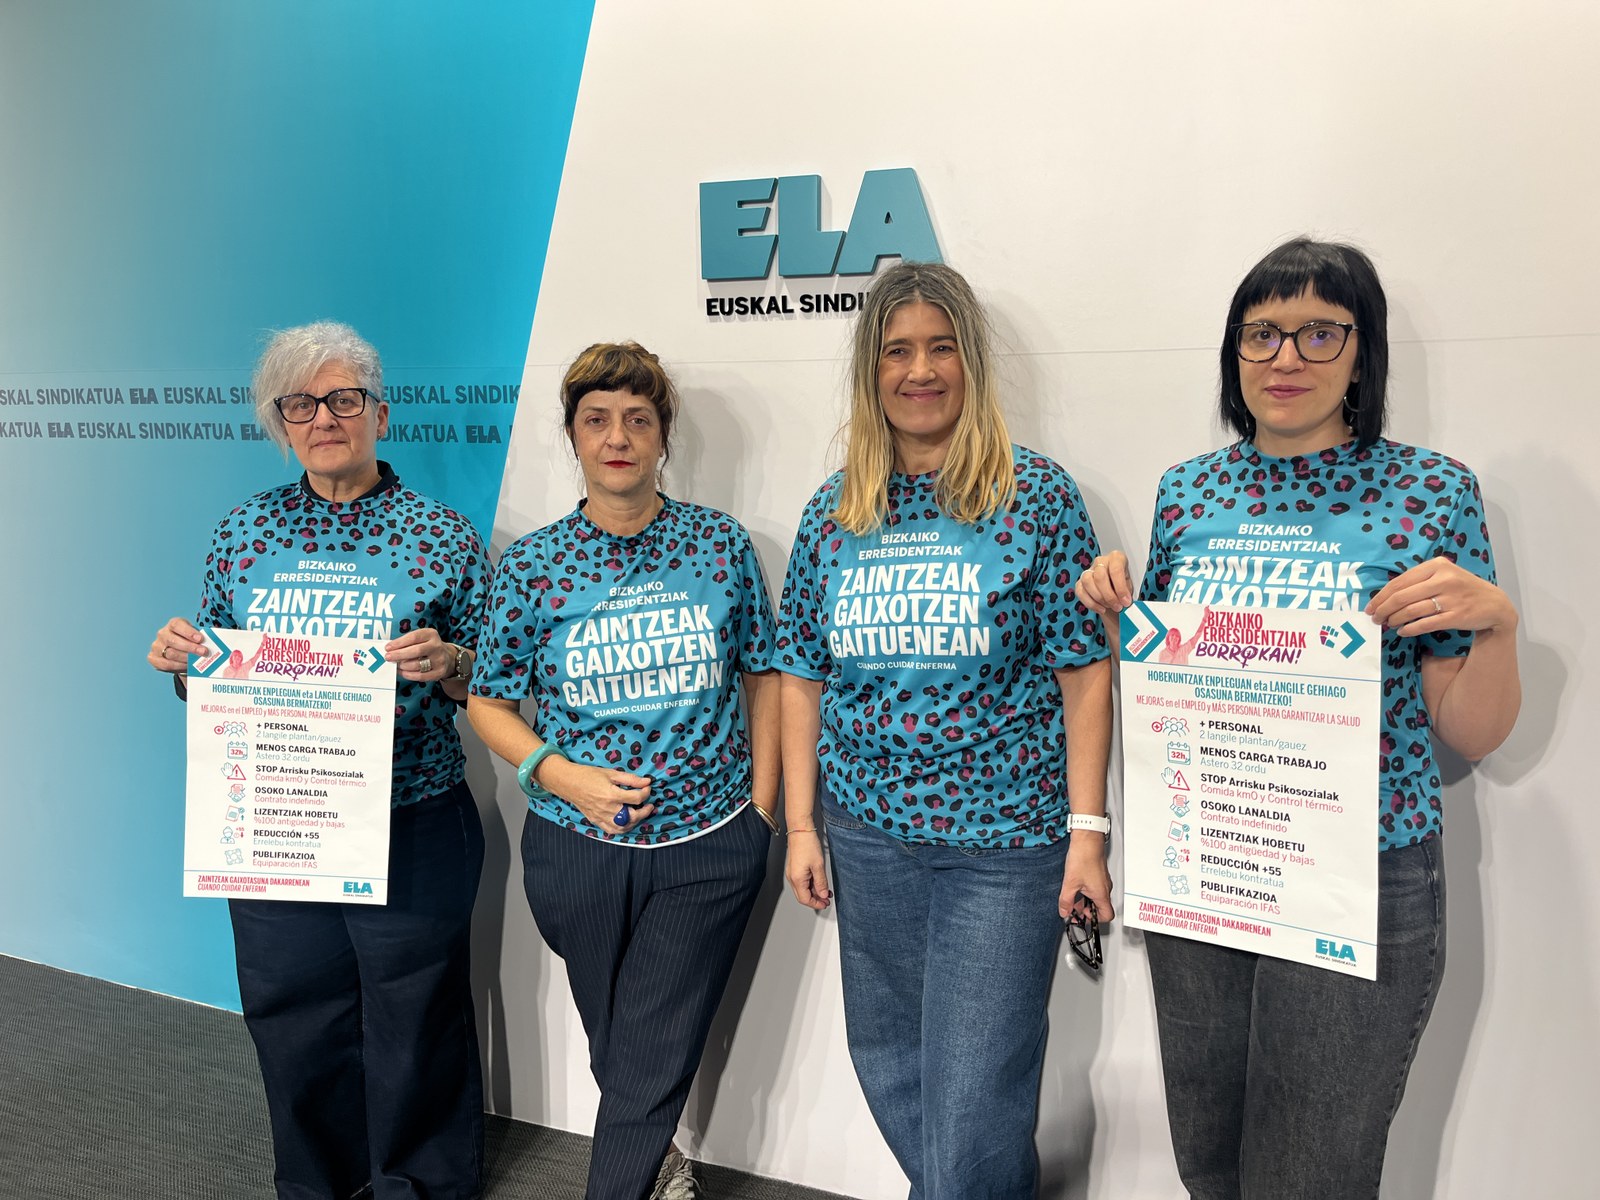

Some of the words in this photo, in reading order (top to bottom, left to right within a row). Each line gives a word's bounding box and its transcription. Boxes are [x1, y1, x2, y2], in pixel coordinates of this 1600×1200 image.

[699, 168, 944, 279] ELA
[706, 295, 794, 316] EUSKAL
[37, 388, 124, 405] SINDIKATUA
[130, 388, 158, 404] ELA
[164, 387, 226, 404] EUSKAL
[382, 386, 450, 404] EUSKAL
[48, 422, 74, 438] ELA
[78, 423, 135, 439] EUSKAL
[139, 423, 234, 440] SINDIKATUA
[466, 425, 501, 443] ELA
[881, 532, 939, 544] BIZKAIKO
[1238, 524, 1312, 536] BIZKAIKO
[859, 546, 962, 560] ERRESIDENTZIAK
[1208, 539, 1341, 554] ERRESIDENTZIAK
[298, 560, 356, 572] BIZKAIKO
[1177, 555, 1364, 589] ZAINTZEAK
[274, 573, 377, 586] ERRESIDENTZIAK
[838, 563, 982, 597] ZAINTZEAK
[609, 581, 663, 597] BIZKAIKO
[247, 588, 395, 618] ZAINTZEAK
[834, 593, 979, 626] GAIXOTZEN
[565, 605, 713, 648] ZAINTZEAK
[1207, 611, 1263, 629] BIZKAIKO
[266, 638, 310, 651] BIZKAIKO
[830, 626, 989, 658] GAITUENEAN
[1204, 626, 1306, 648] ERRESIDENTZIAK
[262, 649, 343, 666] ERRESIDENTZIAK
[566, 632, 717, 678] GAIXOTZEN
[857, 662, 885, 670] CUANDO
[212, 684, 261, 696] HOBEKUNTZAK
[263, 687, 300, 697] ENPLEGUAN
[302, 690, 313, 698] eta
[315, 689, 341, 700] LANGILE
[343, 691, 371, 702] GEHIAGO
[562, 661, 723, 707] GAITUENEAN
[1148, 670, 1204, 686] HOBEKUNTZAK
[1205, 674, 1252, 690] ENPLEGUAN
[1254, 681, 1267, 691] eta
[1269, 681, 1305, 695] LANGILE
[1307, 685, 1346, 698] GEHIAGO
[254, 697, 285, 708] OSASUNA
[287, 699, 332, 710] BERMATZEKO!
[1195, 687, 1234, 702] OSASUNA
[1235, 691, 1292, 707] BERMATZEKO!
[201, 705, 226, 713] MEJORAS
[241, 706, 262, 716] EMPLEO
[281, 708, 308, 718] PERSONAL
[309, 711, 323, 719] PARA
[323, 711, 356, 721] GARANTIZAR
[357, 713, 363, 721] LA
[364, 714, 381, 723] SALUD
[594, 707, 629, 717] CUANDO
[631, 703, 662, 712] CUIDAR
[664, 698, 699, 708] ENFERMA
[1136, 695, 1165, 706] MEJORAS
[1166, 700, 1173, 708] en
[1181, 699, 1206, 711] EMPLEO
[1211, 701, 1226, 713] MÁS
[1227, 704, 1262, 717] PERSONAL
[1263, 708, 1281, 718] PARA
[1282, 709, 1325, 723] GARANTIZAR
[1327, 714, 1336, 724] LA
[1337, 715, 1360, 727] SALUD
[264, 723, 309, 732] PERSONAL
[1208, 721, 1263, 734] PERSONAL
[262, 731, 287, 740] langile
[289, 732, 341, 743] plantan/gauez
[1200, 730, 1205, 739] 2
[1207, 730, 1236, 744] langile
[1239, 734, 1306, 751] plantan/gauez
[256, 744, 286, 752] MENOS
[288, 745, 316, 754] CARGA
[319, 747, 356, 756] TRABAJO
[256, 752, 279, 761] Astero
[293, 754, 310, 762] ordu
[1171, 751, 1185, 760] 32h
[1200, 747, 1236, 759] MENOS
[1239, 751, 1274, 764] CARGA
[1277, 756, 1327, 771] TRABAJO
[256, 765, 277, 773] STOP
[279, 766, 308, 775] Arrisku
[311, 769, 364, 779] Psikosozialak
[1200, 757, 1229, 769] Astero
[1231, 761, 1243, 771] 32
[1245, 763, 1266, 774] ordu
[255, 774, 283, 782] Comida
[311, 777, 336, 786] Control
[338, 778, 366, 788] térmico
[1200, 774, 1227, 785] STOP
[1229, 777, 1266, 790] Arrisku
[1268, 782, 1339, 801] Psikosozialak
[254, 795, 287, 804] Contrato
[289, 797, 325, 806] indefinido
[255, 787, 284, 795] OSOKO
[287, 788, 328, 797] LANALDIA
[1200, 784, 1235, 797] Comida
[1268, 794, 1303, 807] Control
[1305, 799, 1343, 813] térmico
[254, 808, 303, 817] LIZENTZIAK
[305, 810, 338, 819] HOBETU
[1201, 800, 1236, 813] OSOKO
[1238, 806, 1291, 822] LANALDIA
[254, 817, 275, 825] %100
[277, 818, 318, 828] antigüedad
[326, 820, 345, 829] bajas
[1201, 811, 1239, 825] Contrato
[1242, 817, 1287, 832] indefinido
[253, 838, 284, 847] Errelebu
[286, 839, 321, 848] kontratua
[254, 829, 302, 838] REDUCCIÓN
[304, 831, 319, 839] +55
[1201, 827, 1259, 845] LIZENTZIAK
[1262, 837, 1305, 852] HOBETU
[253, 851, 315, 860] PUBLIFIKAZIOA
[1200, 837, 1226, 850] %100
[1228, 844, 1280, 860] antigüedad
[1289, 852, 1315, 866] bajas
[253, 859, 300, 869] Equiparación
[302, 860, 317, 869] IFAS
[1201, 854, 1259, 873] REDUCCIÓN
[1262, 865, 1281, 876] +55
[198, 875, 228, 883] ZAINTZEAK
[230, 876, 268, 885] GAIXOTASUNA
[270, 877, 310, 887] DAKARRENEAN
[1201, 865, 1238, 879] Errelebu
[1240, 871, 1284, 888] kontratua
[242, 885, 266, 893] ENFERMA
[344, 882, 372, 894] ELA
[1201, 880, 1277, 903] PUBLIFIKAZIOA
[1201, 891, 1258, 909] Equiparación
[1260, 902, 1280, 915] IFAS
[1139, 902, 1174, 916] ZAINTZEAK
[1175, 908, 1221, 927] GAIXOTASUNA
[1222, 917, 1271, 936] DAKARRENEAN
[1139, 912, 1164, 925] CUANDO
[1165, 918, 1188, 930] CUIDAR
[1189, 922, 1218, 935] ENFERMA
[1315, 938, 1356, 962] ELA
